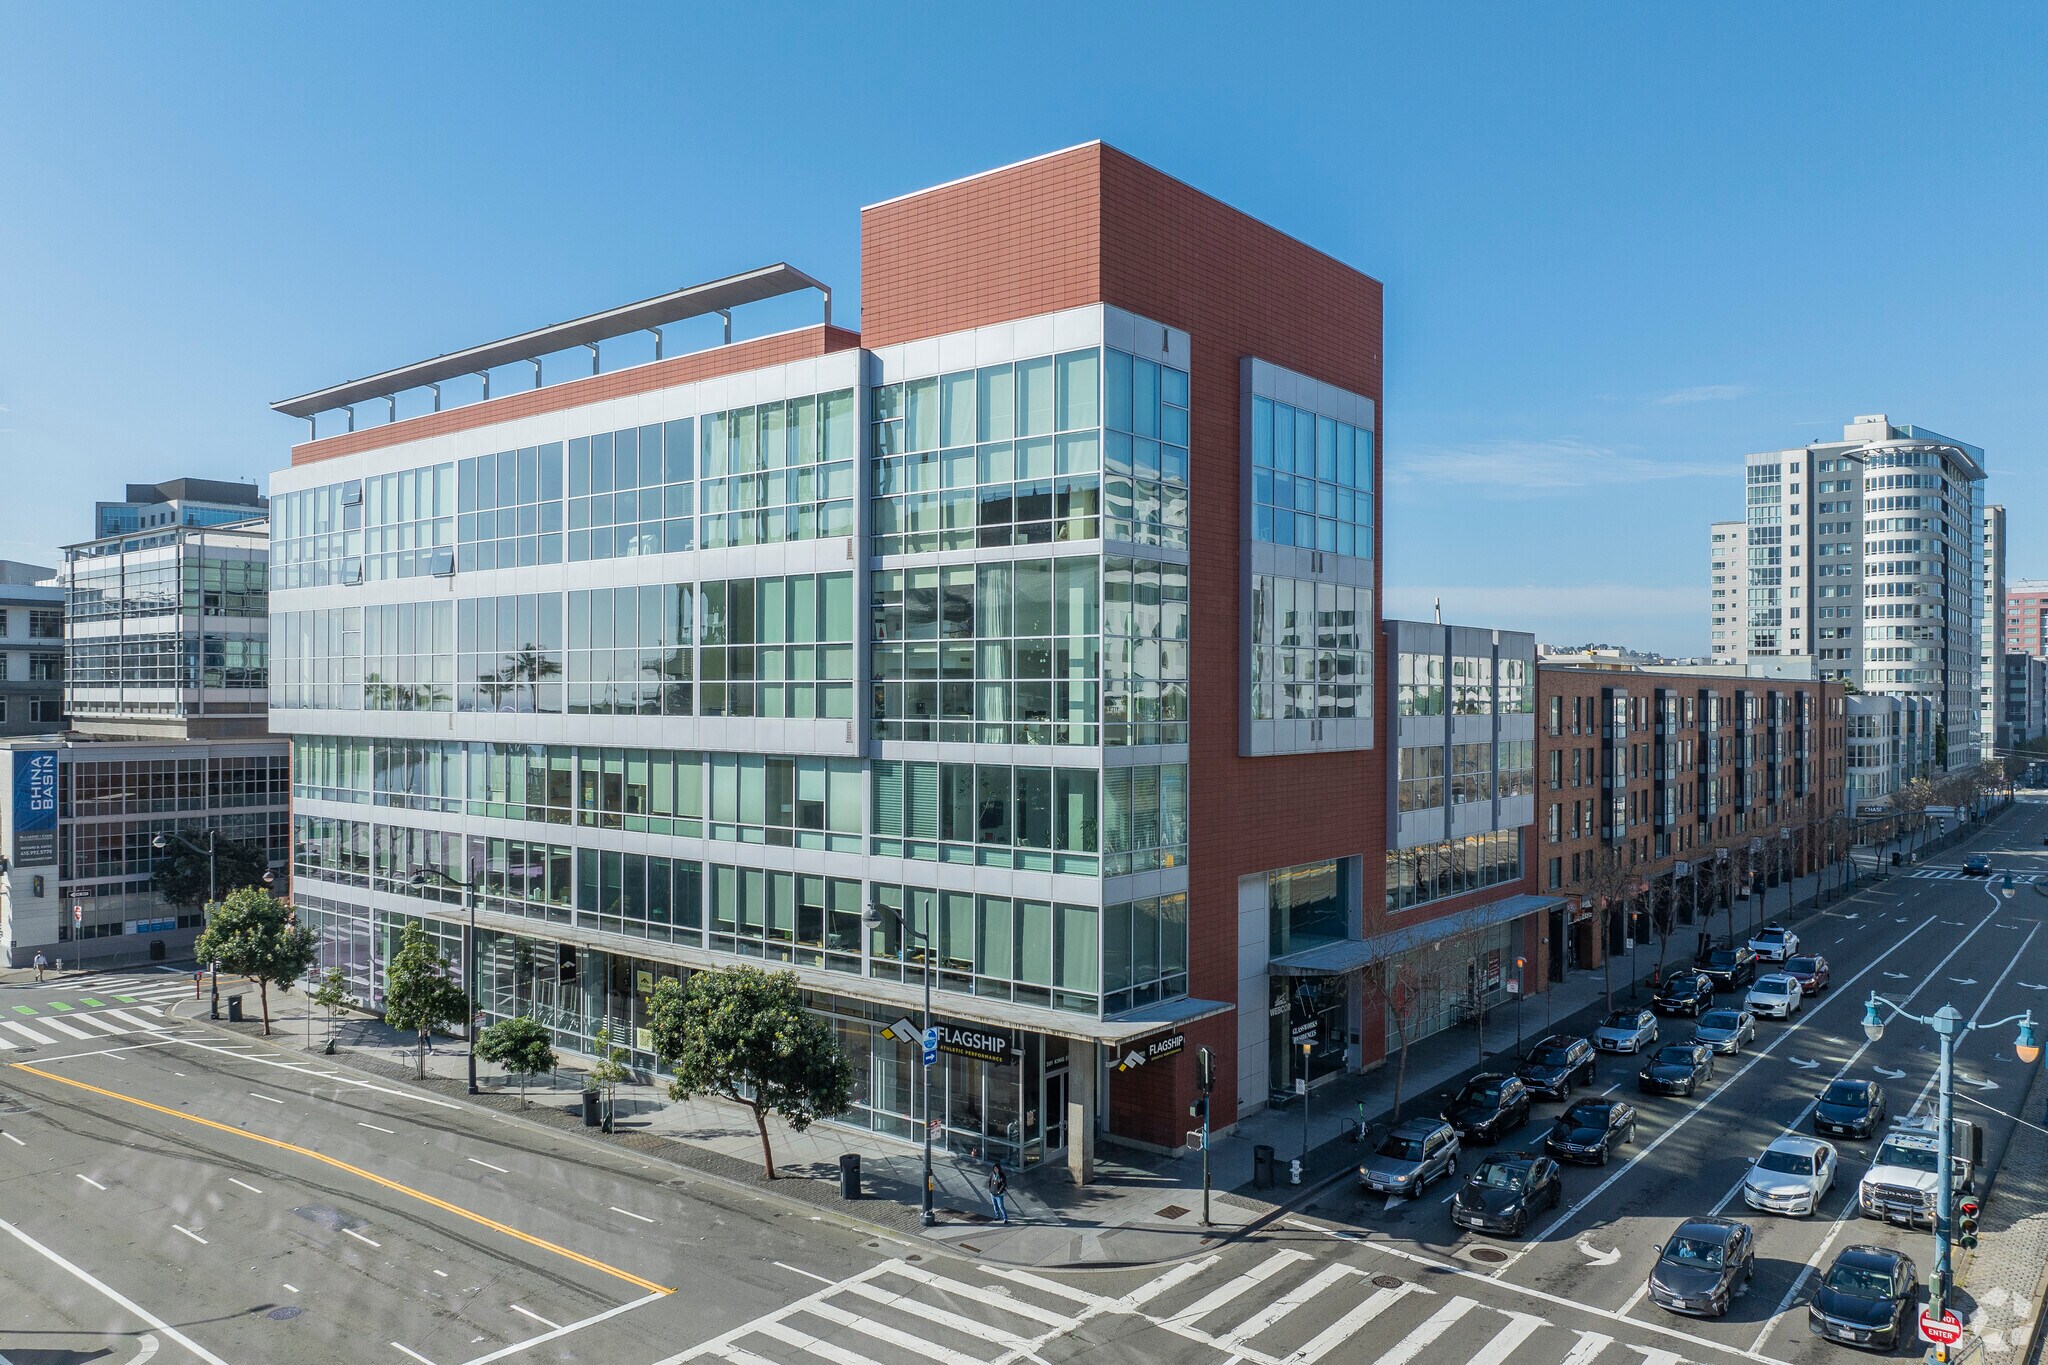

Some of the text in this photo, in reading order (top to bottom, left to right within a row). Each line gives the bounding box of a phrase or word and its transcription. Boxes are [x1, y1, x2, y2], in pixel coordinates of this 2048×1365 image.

[31, 756, 41, 810] CHINA
[43, 756, 53, 810] BASIN
[1270, 1003, 1291, 1017] WEBCOR
[1292, 1020, 1318, 1035] GLASSWORKS
[937, 1026, 1006, 1053] FLAGSHIP
[1149, 1035, 1184, 1056] FLAGSHIP
[940, 1045, 1003, 1063] ATHLETIC PERFORMANCE
[1928, 1328, 1953, 1340] ENTER
